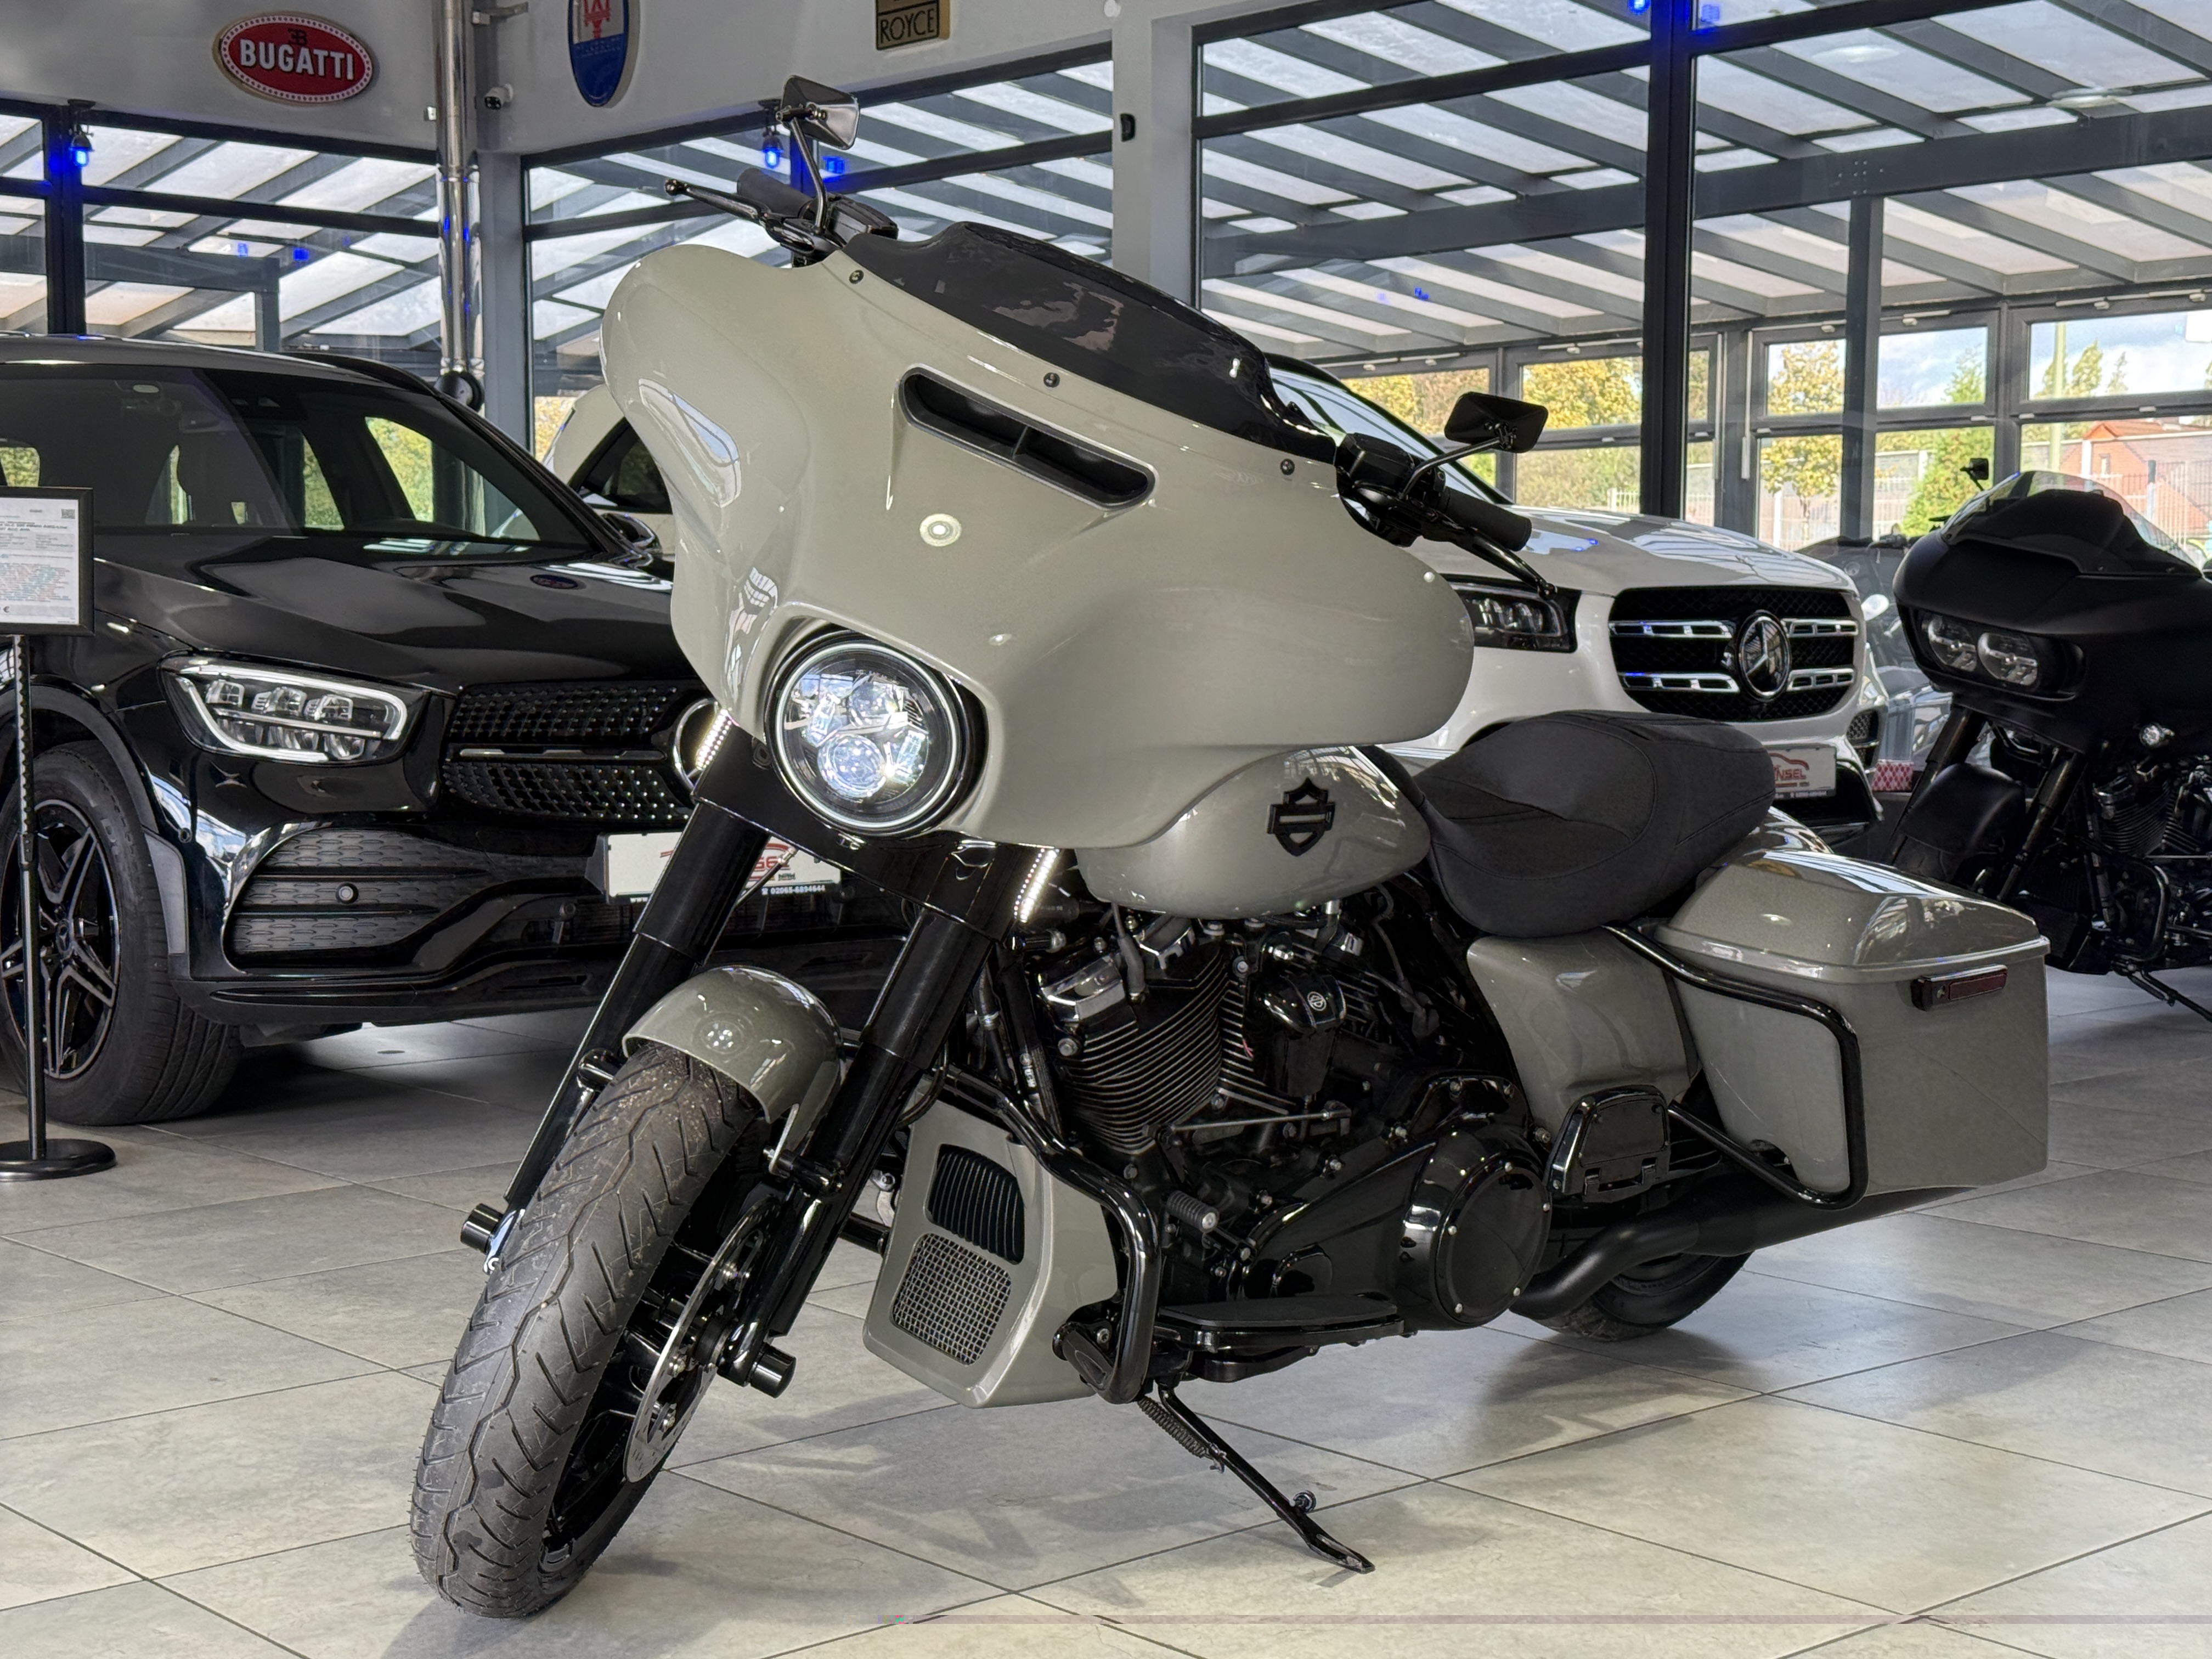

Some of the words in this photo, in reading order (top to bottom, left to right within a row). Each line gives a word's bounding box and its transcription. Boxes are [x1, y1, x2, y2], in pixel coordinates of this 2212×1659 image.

[879, 8, 935, 43] ROYCE
[239, 38, 354, 81] BUGATTI
[1774, 764, 1807, 781] NSEL
